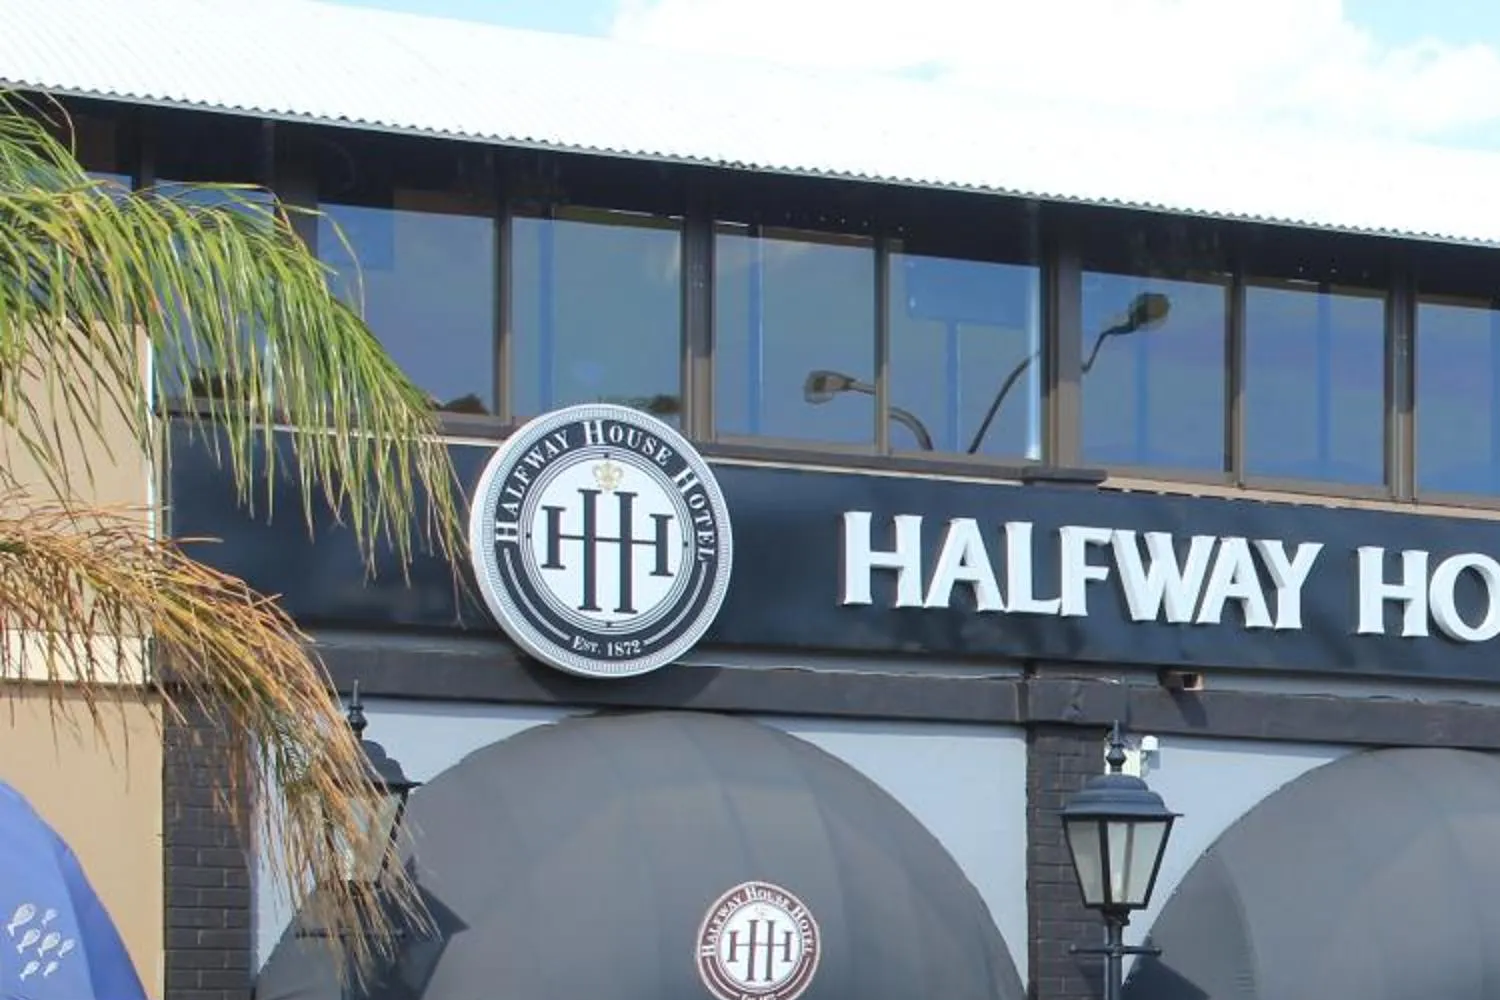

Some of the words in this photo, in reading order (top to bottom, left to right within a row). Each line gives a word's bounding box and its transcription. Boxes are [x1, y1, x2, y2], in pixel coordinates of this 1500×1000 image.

[494, 429, 570, 545] HALFWAY
[583, 420, 674, 466] HOUSE
[671, 467, 716, 562] HOTEL
[842, 511, 1324, 630] HALFWAY
[607, 639, 641, 657] 1872
